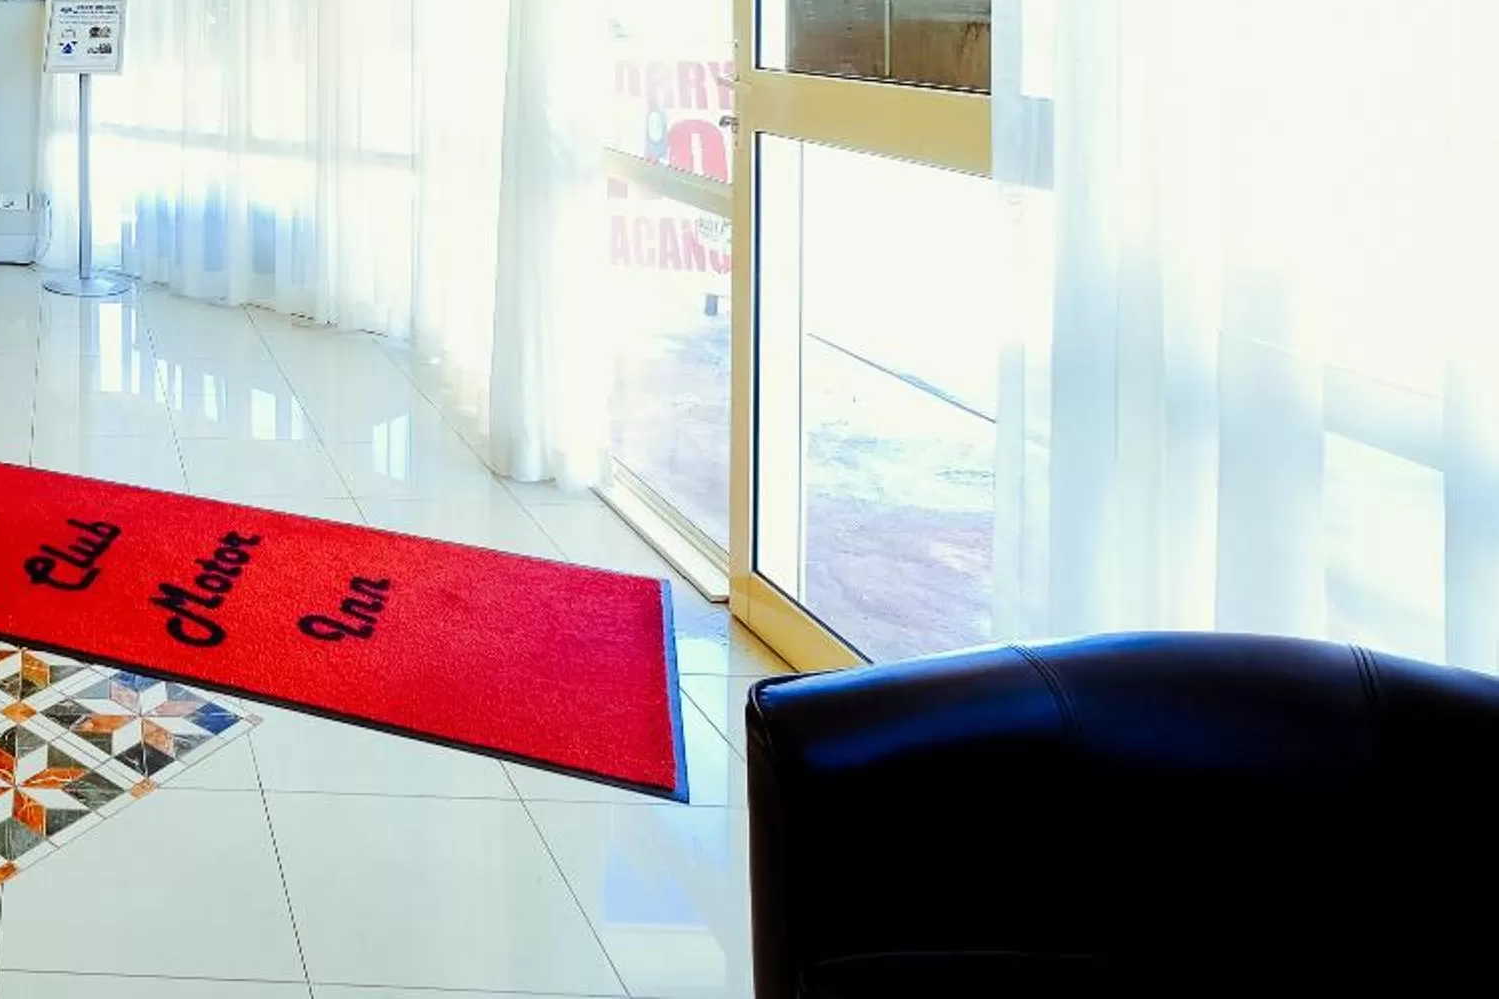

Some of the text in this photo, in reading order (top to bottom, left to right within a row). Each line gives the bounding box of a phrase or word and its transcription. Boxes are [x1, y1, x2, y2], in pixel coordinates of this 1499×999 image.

[23, 518, 122, 591] Club
[150, 530, 262, 648] Motor
[296, 575, 391, 642] Inn
